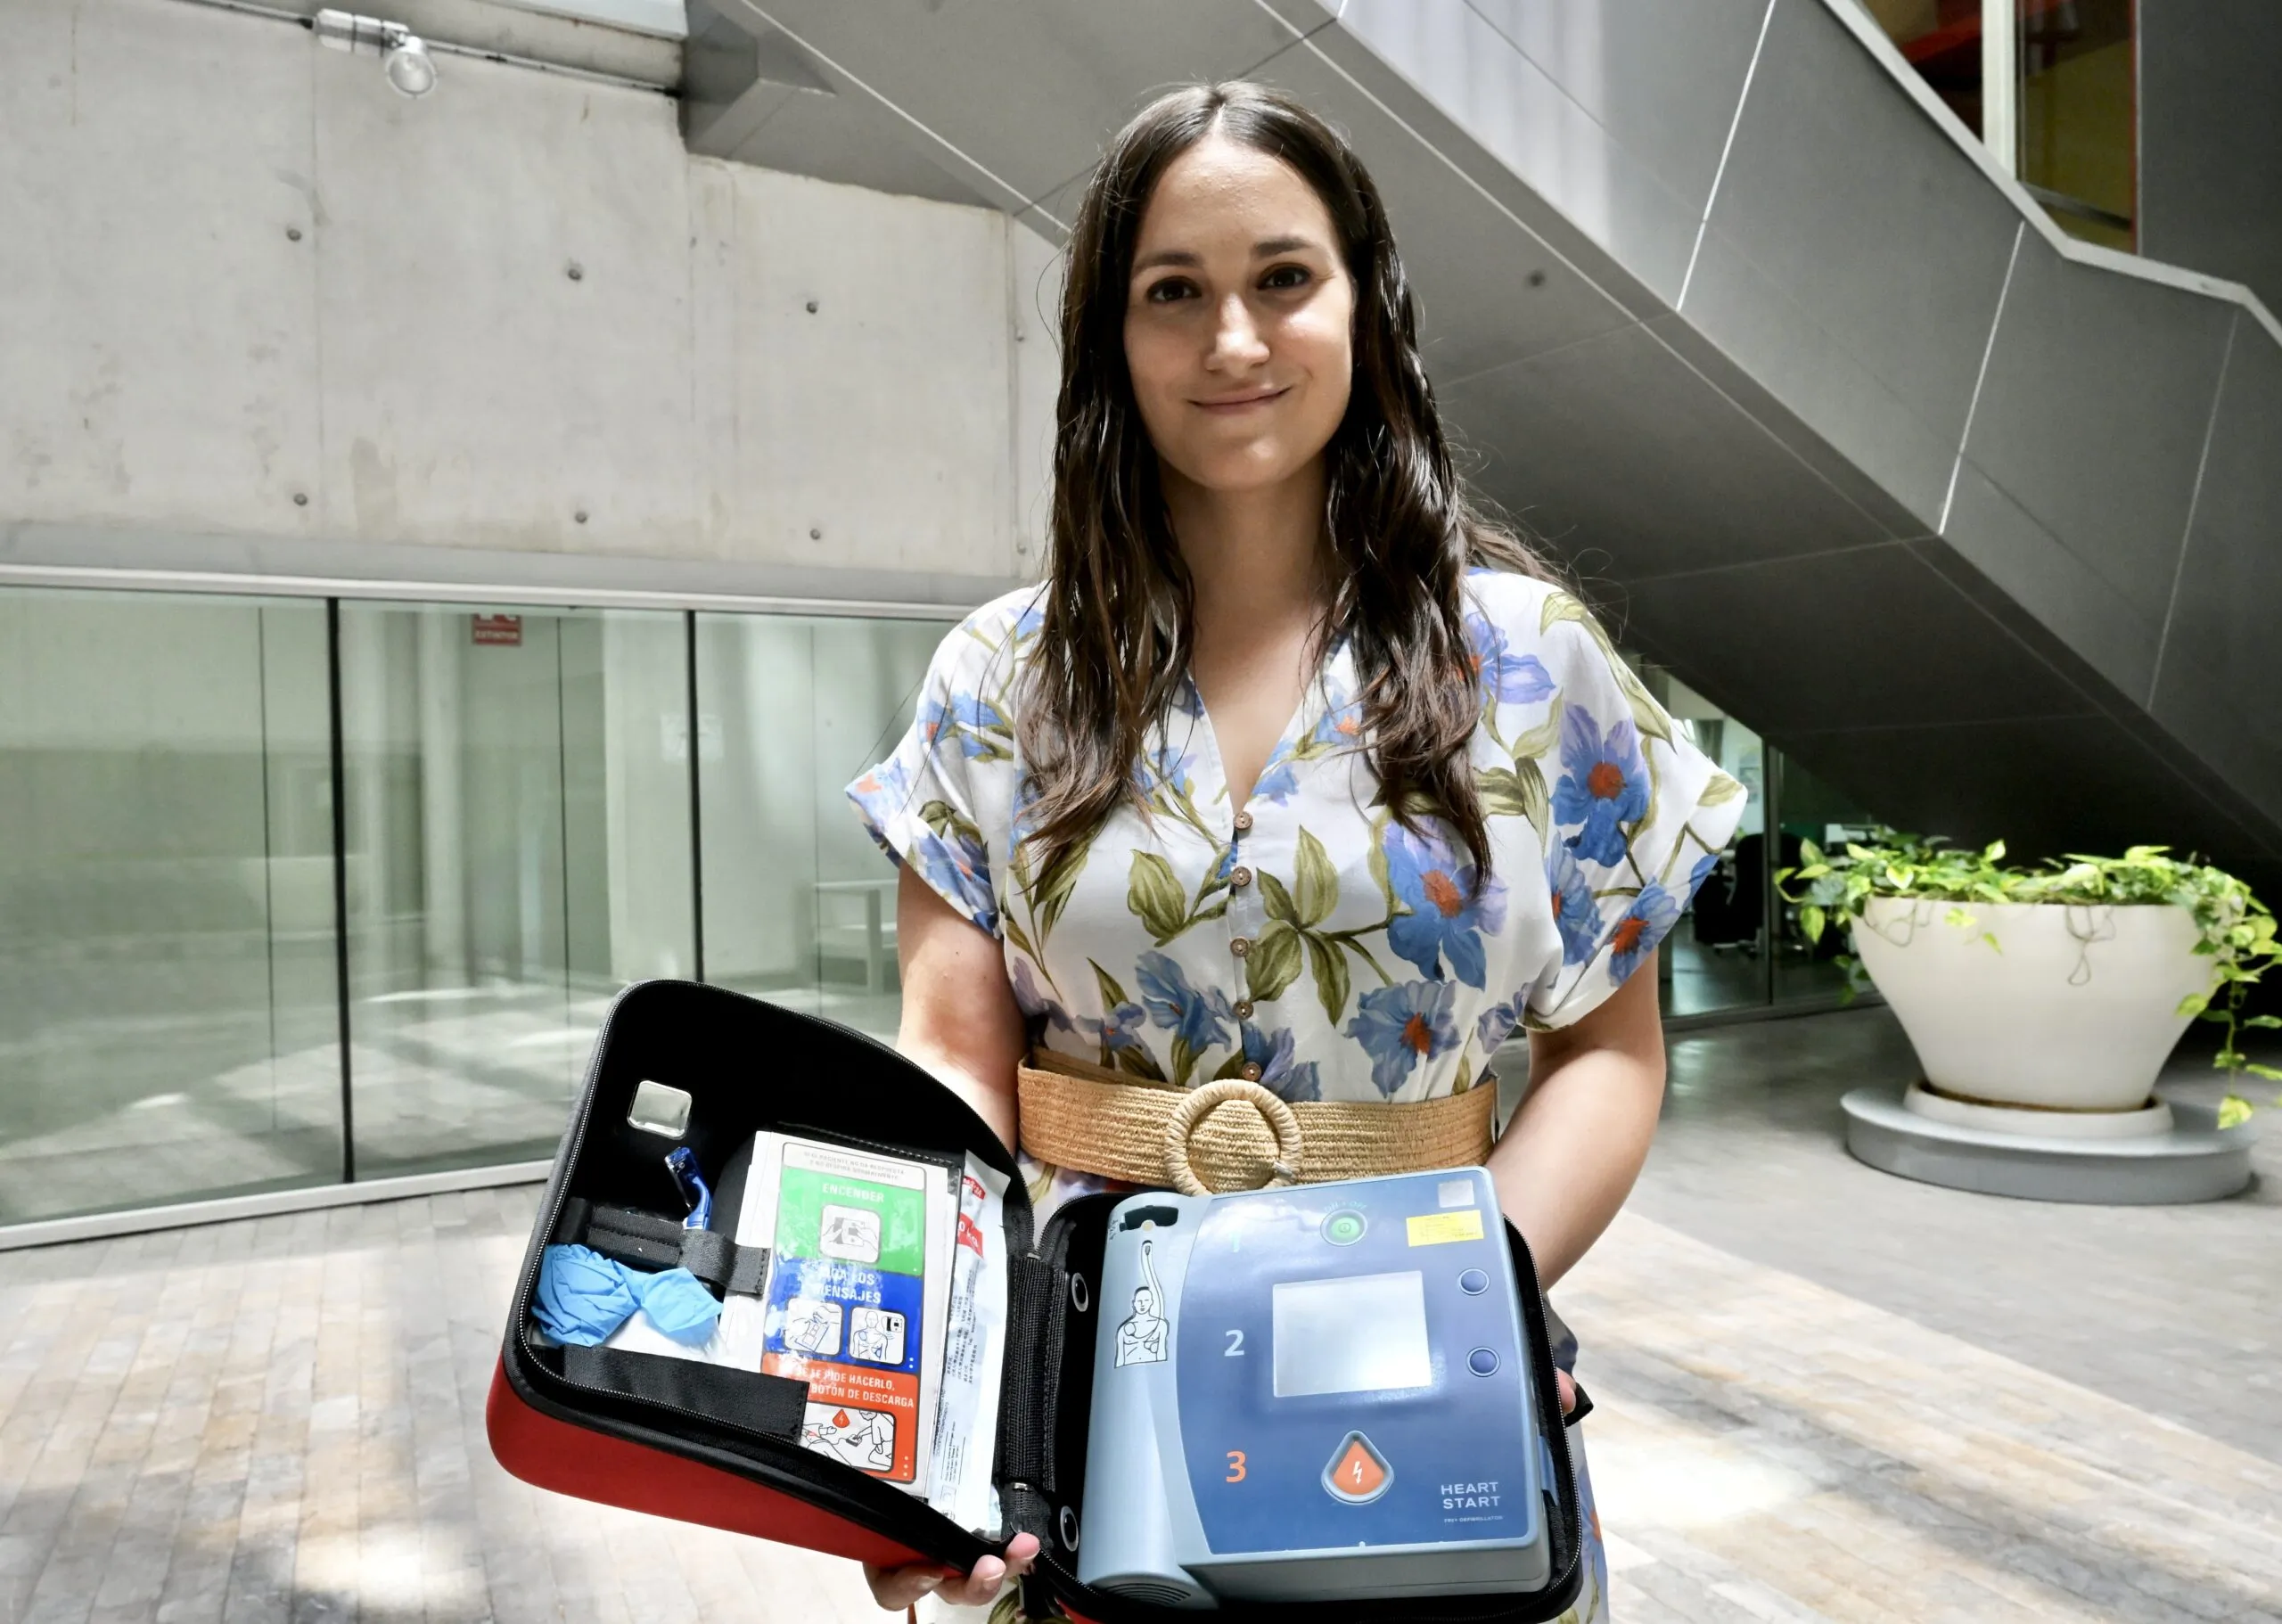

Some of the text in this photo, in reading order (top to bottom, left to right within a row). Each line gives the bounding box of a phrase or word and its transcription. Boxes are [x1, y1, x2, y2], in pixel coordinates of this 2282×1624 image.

[823, 1183, 884, 1202] ENCENDER
[1224, 1329, 1245, 1357] 2
[849, 1374, 895, 1391] HACERLO,
[810, 1382, 915, 1408] BOTÓN DE DESCARGA
[1226, 1450, 1247, 1483] 3
[1441, 1481, 1498, 1495] HEART
[1442, 1496, 1501, 1509] START
